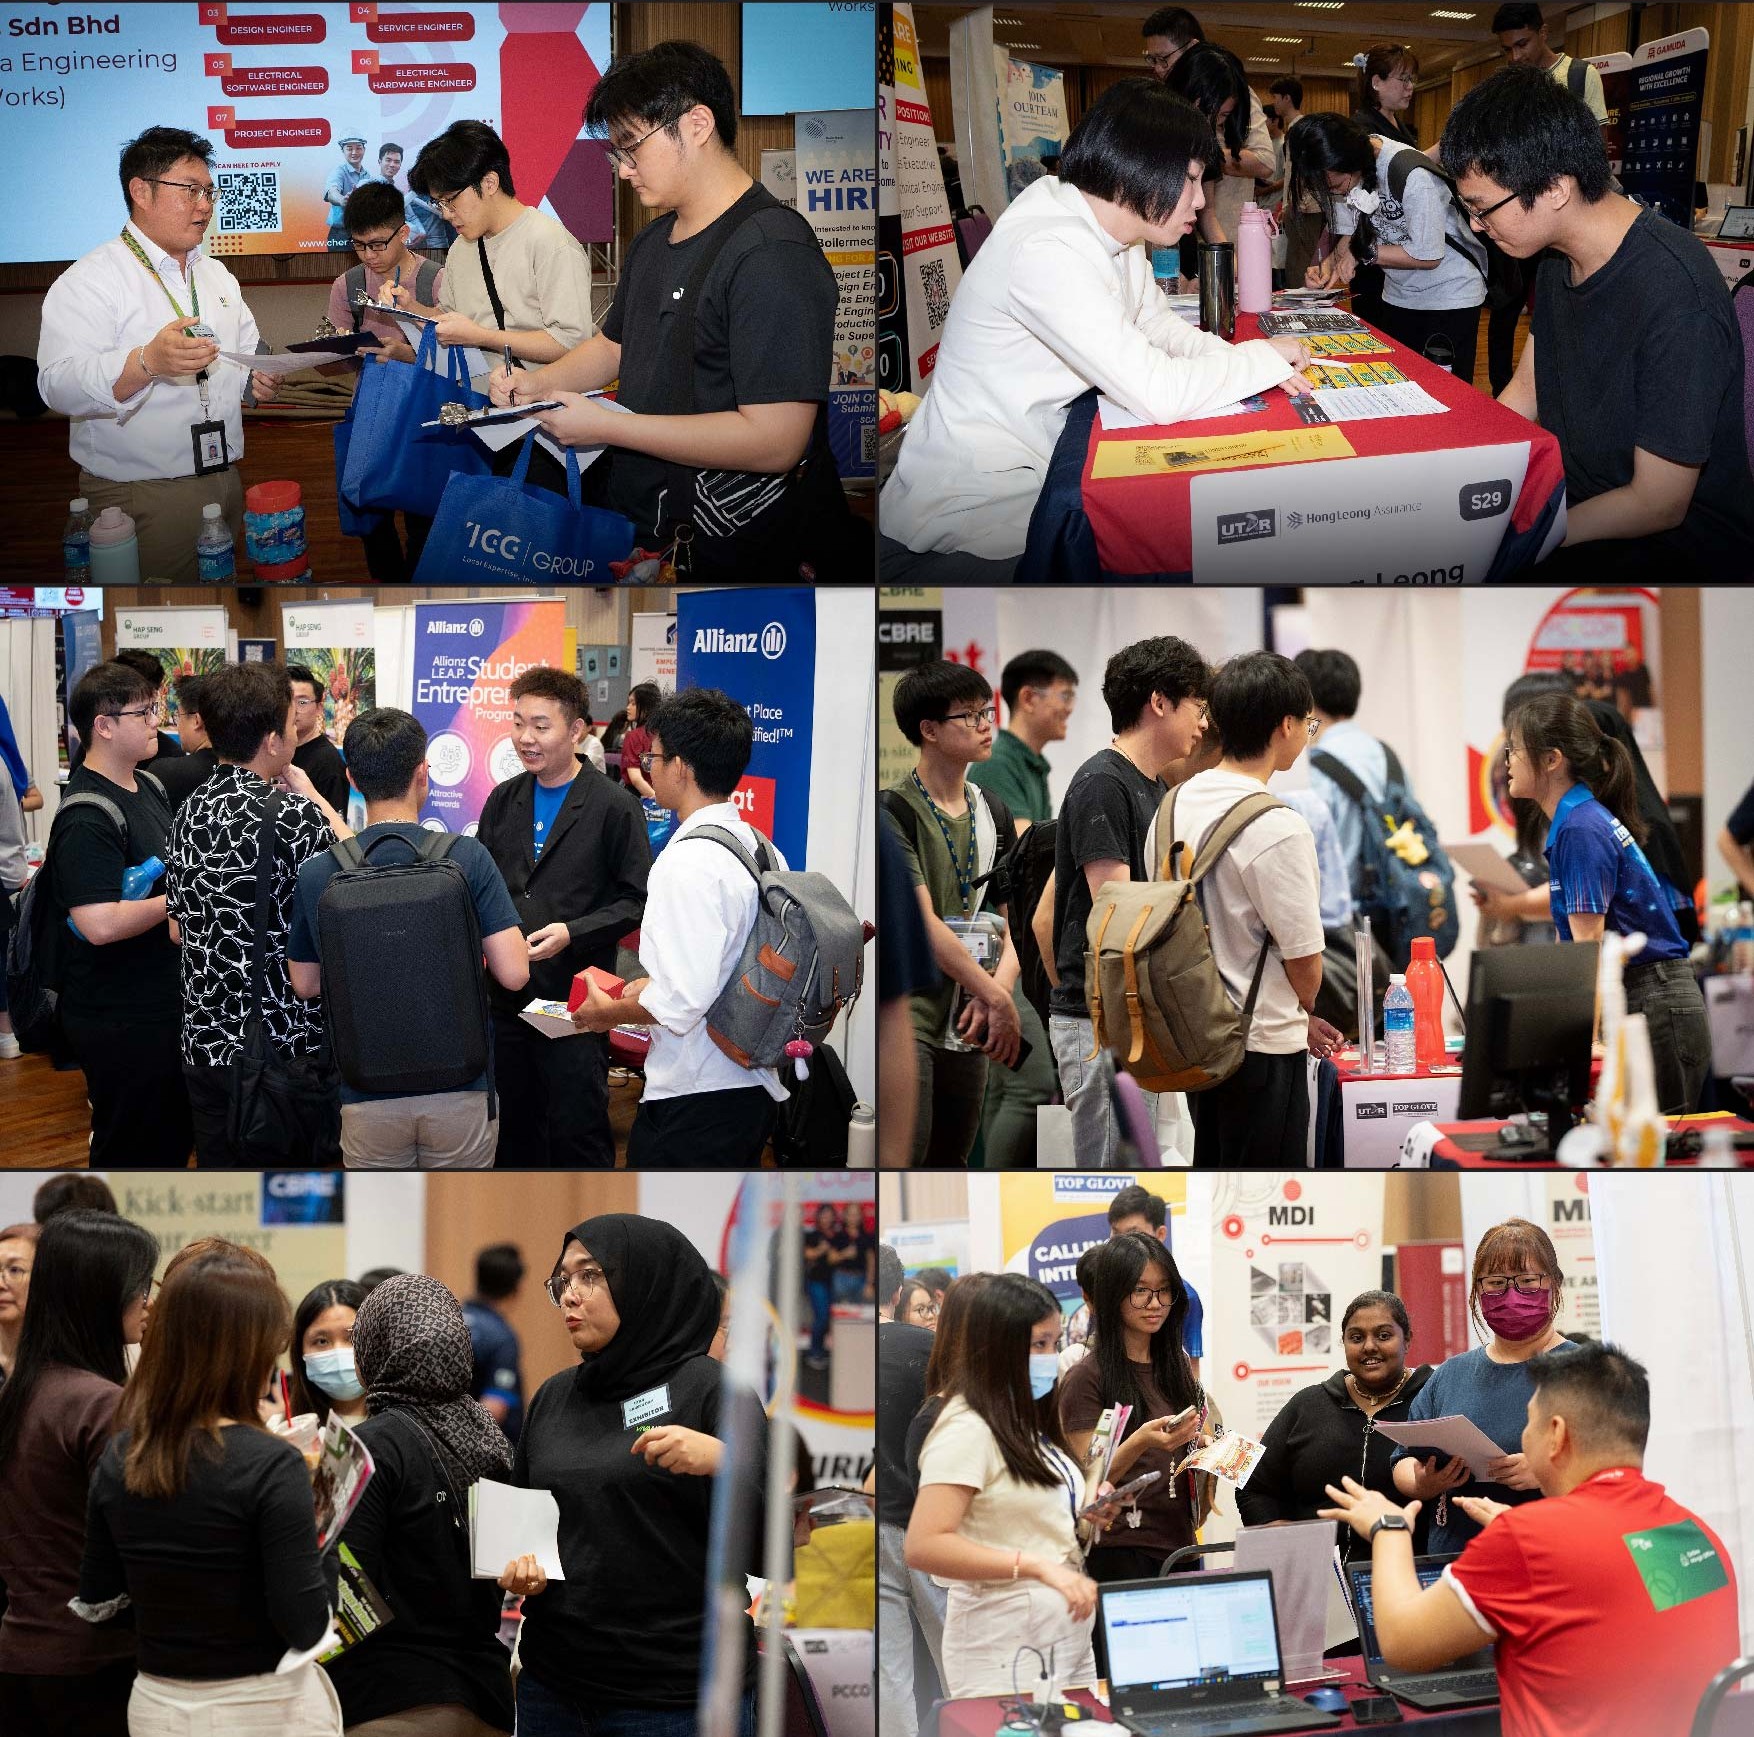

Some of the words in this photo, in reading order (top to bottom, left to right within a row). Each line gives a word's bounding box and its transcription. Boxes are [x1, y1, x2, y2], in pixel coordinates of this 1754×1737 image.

[207, 8, 219, 18] 03
[357, 6, 370, 15] 04
[9, 16, 59, 37] Sdn
[67, 14, 121, 35] Bhd
[230, 26, 264, 35] DESIGN
[267, 24, 313, 34] ENGINEER
[378, 23, 416, 32] SERVICE
[418, 22, 463, 31] ENGINEER
[1657, 40, 1686, 55] GAMUDA
[22, 48, 178, 75] Engineering
[212, 60, 225, 69] 05
[359, 57, 372, 66] 06
[248, 71, 302, 80] ELECTRICAL
[396, 69, 449, 77] ELECTRICAL
[1639, 72, 1664, 85] REGIONAL
[1665, 66, 1691, 78] GROWTH
[226, 83, 277, 93] SOFTWARE
[279, 82, 325, 91] ENGINEER
[372, 80, 426, 90] HARDWARE
[427, 79, 473, 89] ENGINEER
[1653, 75, 1688, 89] EXCELLENCE
[215, 113, 228, 122] 07
[1035, 104, 1058, 118] TEAM
[234, 129, 274, 139] PROJECT
[276, 128, 322, 137] ENGINEER
[806, 169, 835, 184] WE
[840, 168, 875, 183] ARE
[833, 395, 860, 406] JOIN
[1471, 491, 1502, 511] S29
[532, 551, 595, 578] GROUP
[427, 620, 467, 635] Allianz
[879, 622, 935, 644] CBRE
[693, 628, 758, 654] Allianz
[433, 655, 467, 668] Allianz
[753, 704, 783, 721] Place
[429, 789, 463, 800] Attractive
[431, 800, 460, 810] rewards
[1393, 1103, 1410, 1111] TOP
[1056, 1176, 1085, 1190] TOP
[1268, 1205, 1315, 1226] MDI
[628, 1405, 664, 1424] EXHIBITOR
